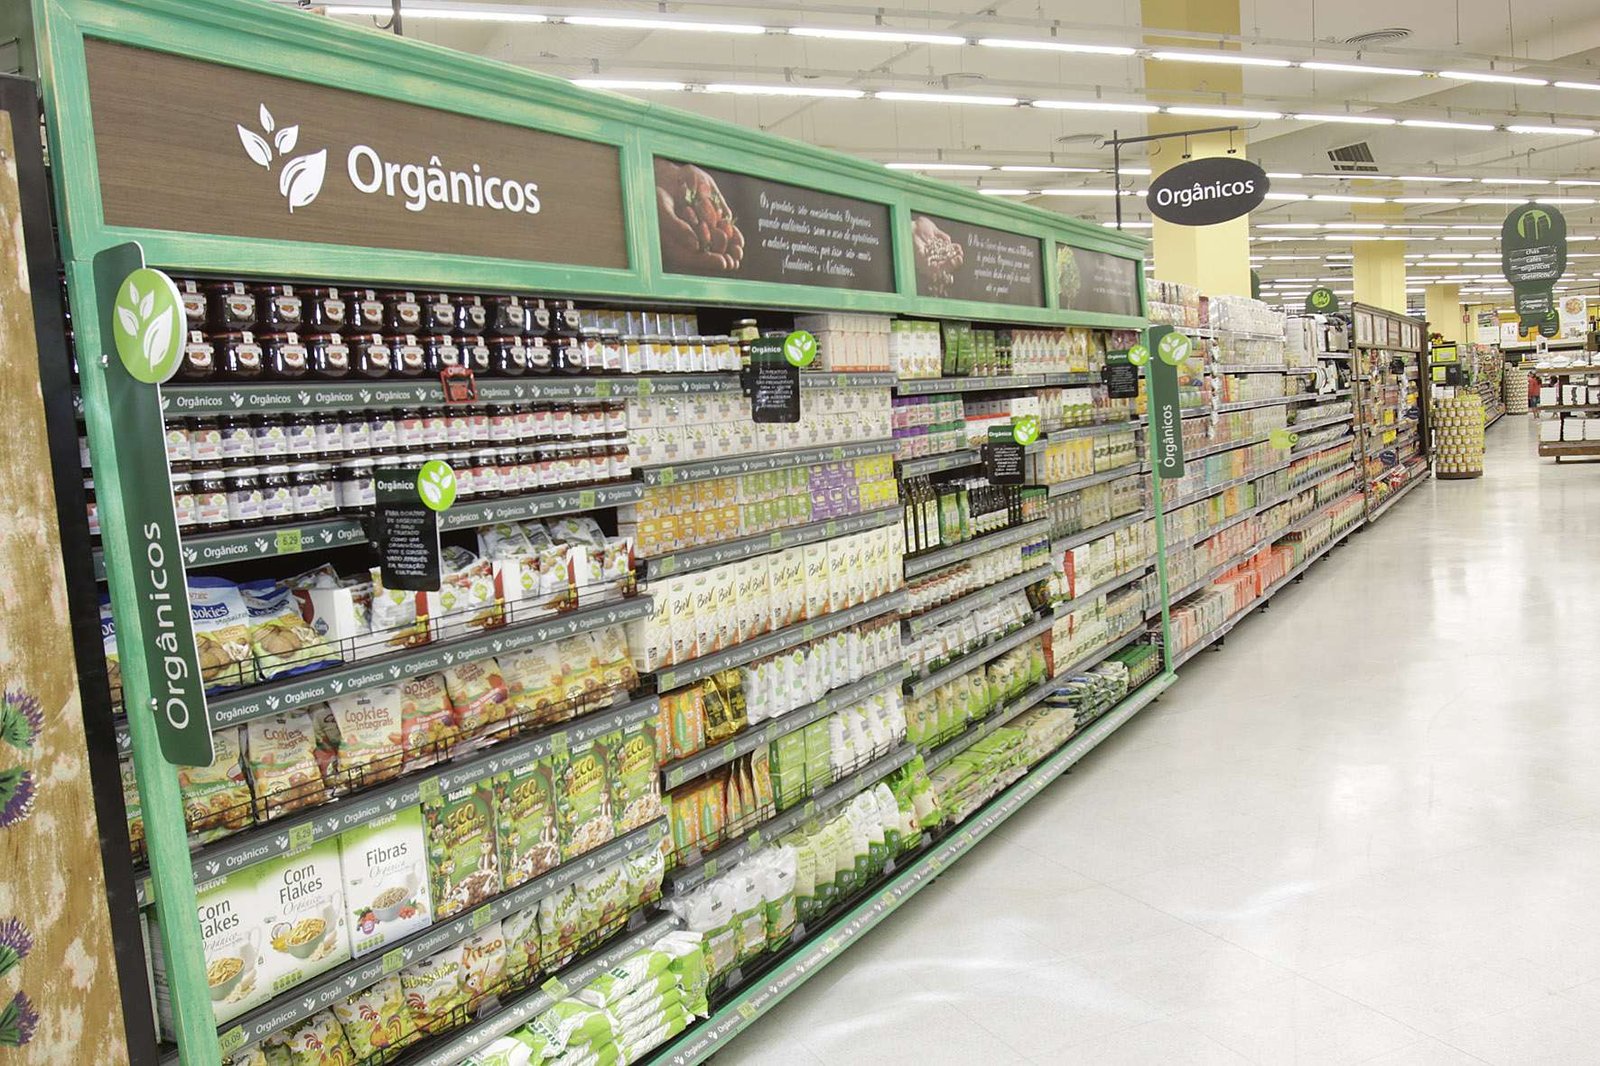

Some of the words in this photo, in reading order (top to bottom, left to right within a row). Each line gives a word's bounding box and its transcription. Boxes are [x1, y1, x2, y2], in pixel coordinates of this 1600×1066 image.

[347, 143, 541, 215] Orgânicos
[1156, 179, 1254, 208] Orgânicos
[751, 345, 781, 355] Orgânico
[176, 396, 222, 408] Orgânicos
[250, 393, 291, 406] Orgânicos
[316, 391, 354, 404] Orgânicos
[375, 390, 410, 401] Orgânicos
[480, 387, 510, 398] Orgânicos
[543, 386, 570, 396] Orgânicos
[1164, 404, 1175, 468] Orgânicos
[377, 480, 414, 492] Orgânico
[204, 543, 248, 559] Orgânicos
[448, 513, 479, 525] Orgânicos
[496, 507, 525, 518] Orgânicos
[192, 606, 228, 620] ookies
[144, 522, 189, 729] Orgânicos
[215, 703, 259, 722] Orgânicos
[284, 685, 325, 703] Orgânicos
[347, 671, 384, 687] Orgânicos
[404, 658, 438, 673] Orgânicos
[456, 646, 488, 660] Orgânicos
[505, 634, 534, 648] Orgânicos
[345, 706, 389, 723] Cookies
[626, 738, 644, 758] ECO
[574, 757, 594, 780] ECO
[448, 786, 474, 802] Native
[513, 779, 537, 801] ECO
[226, 845, 269, 867] Orgânicos
[344, 804, 381, 824] Orgânicos
[454, 768, 484, 784] Orgânicos
[502, 752, 530, 767] Orgânicos
[447, 804, 474, 828] ECO
[368, 814, 397, 830] Native
[366, 841, 408, 867] Fibras
[283, 863, 315, 886] Corn
[279, 875, 323, 904] Flakes
[197, 899, 231, 924] Corn
[199, 912, 240, 941] lakes
[256, 1009, 297, 1034] Orgânicos
[417, 932, 450, 953] Orgânicos
[514, 885, 543, 904] Orgânicos
[431, 1044, 465, 1066] Orgânicos
[480, 1017, 512, 1037] Orgânicos
[569, 966, 597, 986] Orgânicos
[220, 1032, 241, 1049] 10,09
